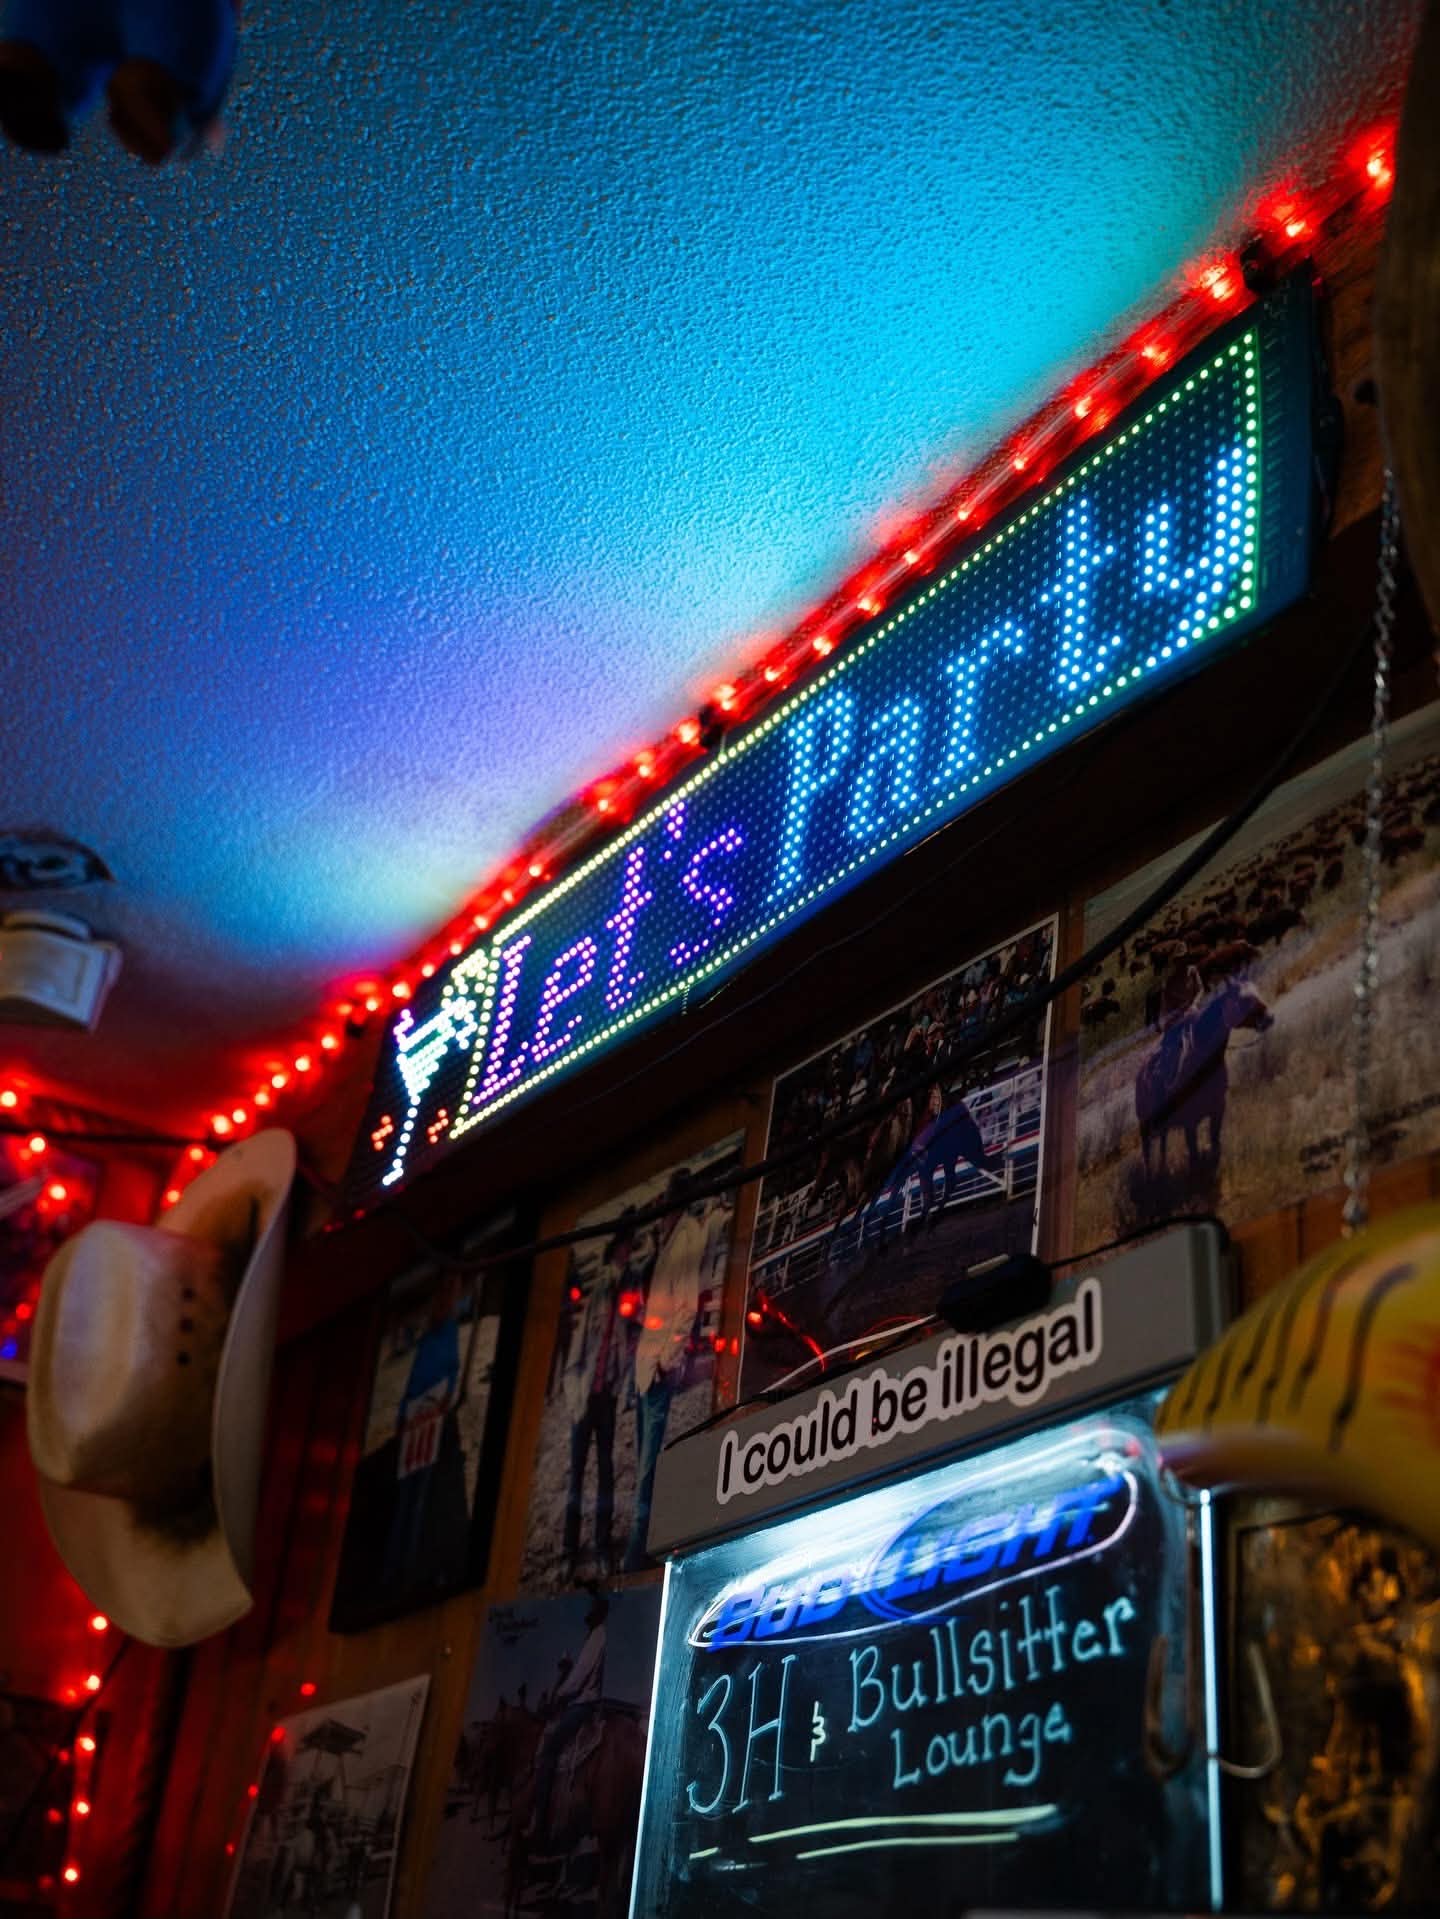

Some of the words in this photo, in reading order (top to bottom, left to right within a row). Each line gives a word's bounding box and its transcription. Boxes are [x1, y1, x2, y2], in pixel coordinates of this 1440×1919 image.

[472, 800, 746, 1107] Let's
[766, 444, 1242, 906] Party
[722, 1441, 735, 1495] I
[743, 1400, 857, 1484] could
[871, 1380, 928, 1434] be
[941, 1290, 1096, 1406] illegal
[886, 1472, 1124, 1602] LIGHT
[687, 1653, 797, 1815] 3H
[847, 1584, 1136, 1734] Bullsitter
[890, 1700, 1073, 1790] Lounge
